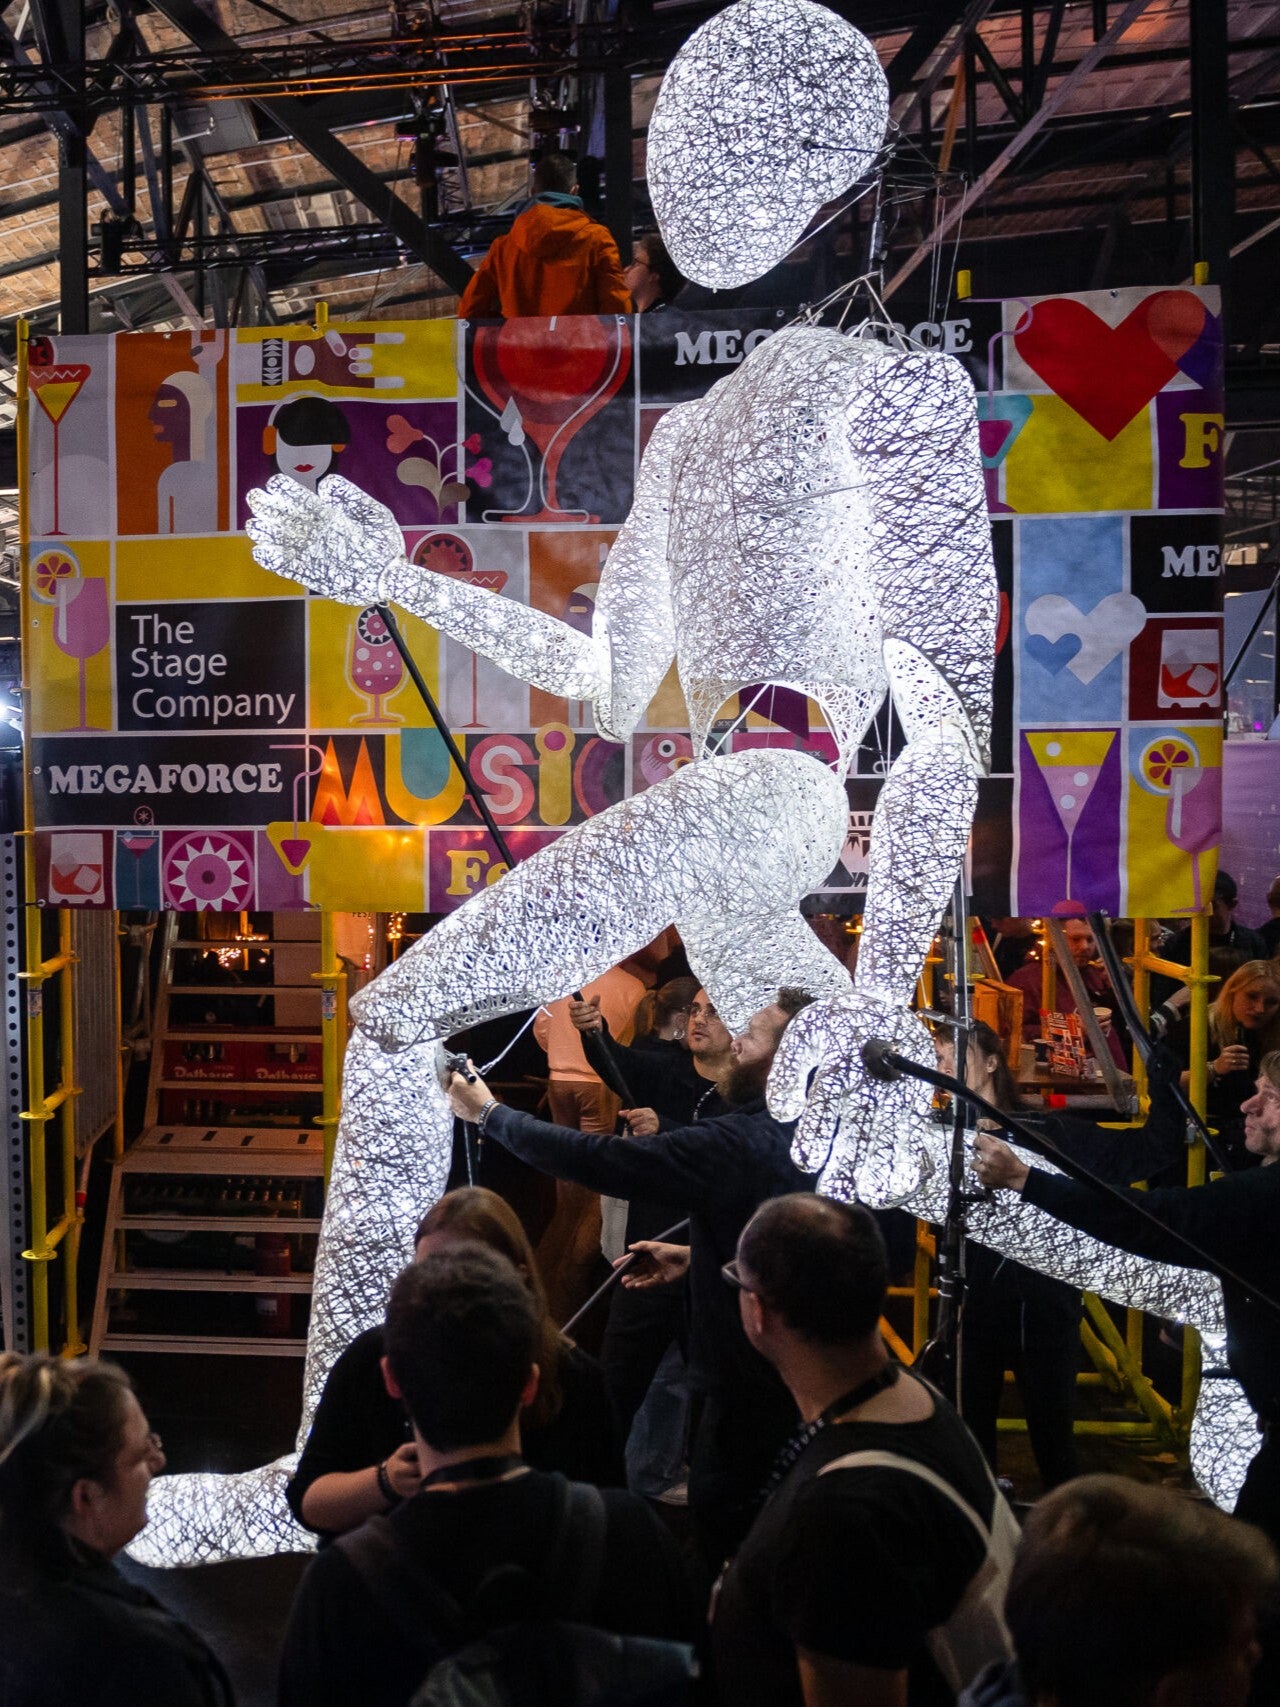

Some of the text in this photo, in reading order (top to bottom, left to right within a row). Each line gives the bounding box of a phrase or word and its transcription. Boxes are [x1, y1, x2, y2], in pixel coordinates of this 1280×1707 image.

[1160, 545, 1226, 578] ME
[130, 614, 195, 645] The
[130, 647, 229, 685] Stage
[131, 687, 297, 726] Company
[48, 762, 284, 796] MEGAFORCE
